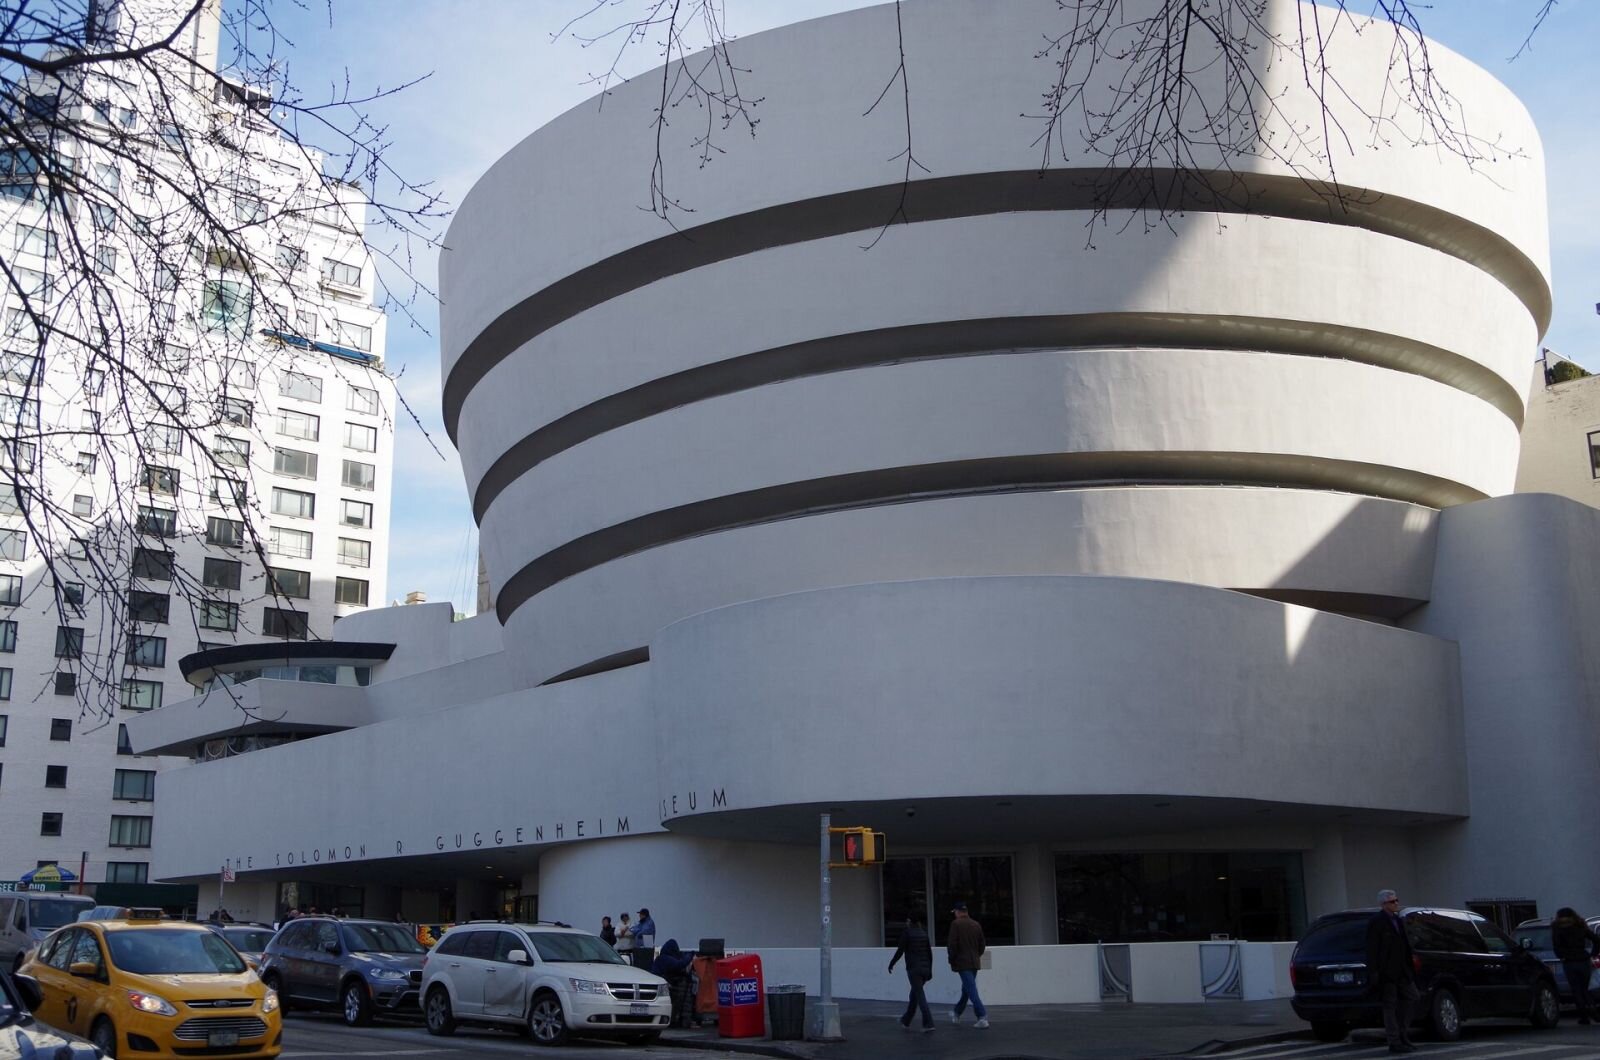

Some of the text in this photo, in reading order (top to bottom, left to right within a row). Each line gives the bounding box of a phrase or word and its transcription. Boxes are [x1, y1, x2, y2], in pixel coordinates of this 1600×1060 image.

[226, 787, 727, 870] THE SOLOMON R GUGGENHEIM SEUM
[735, 981, 757, 993] VOICE
